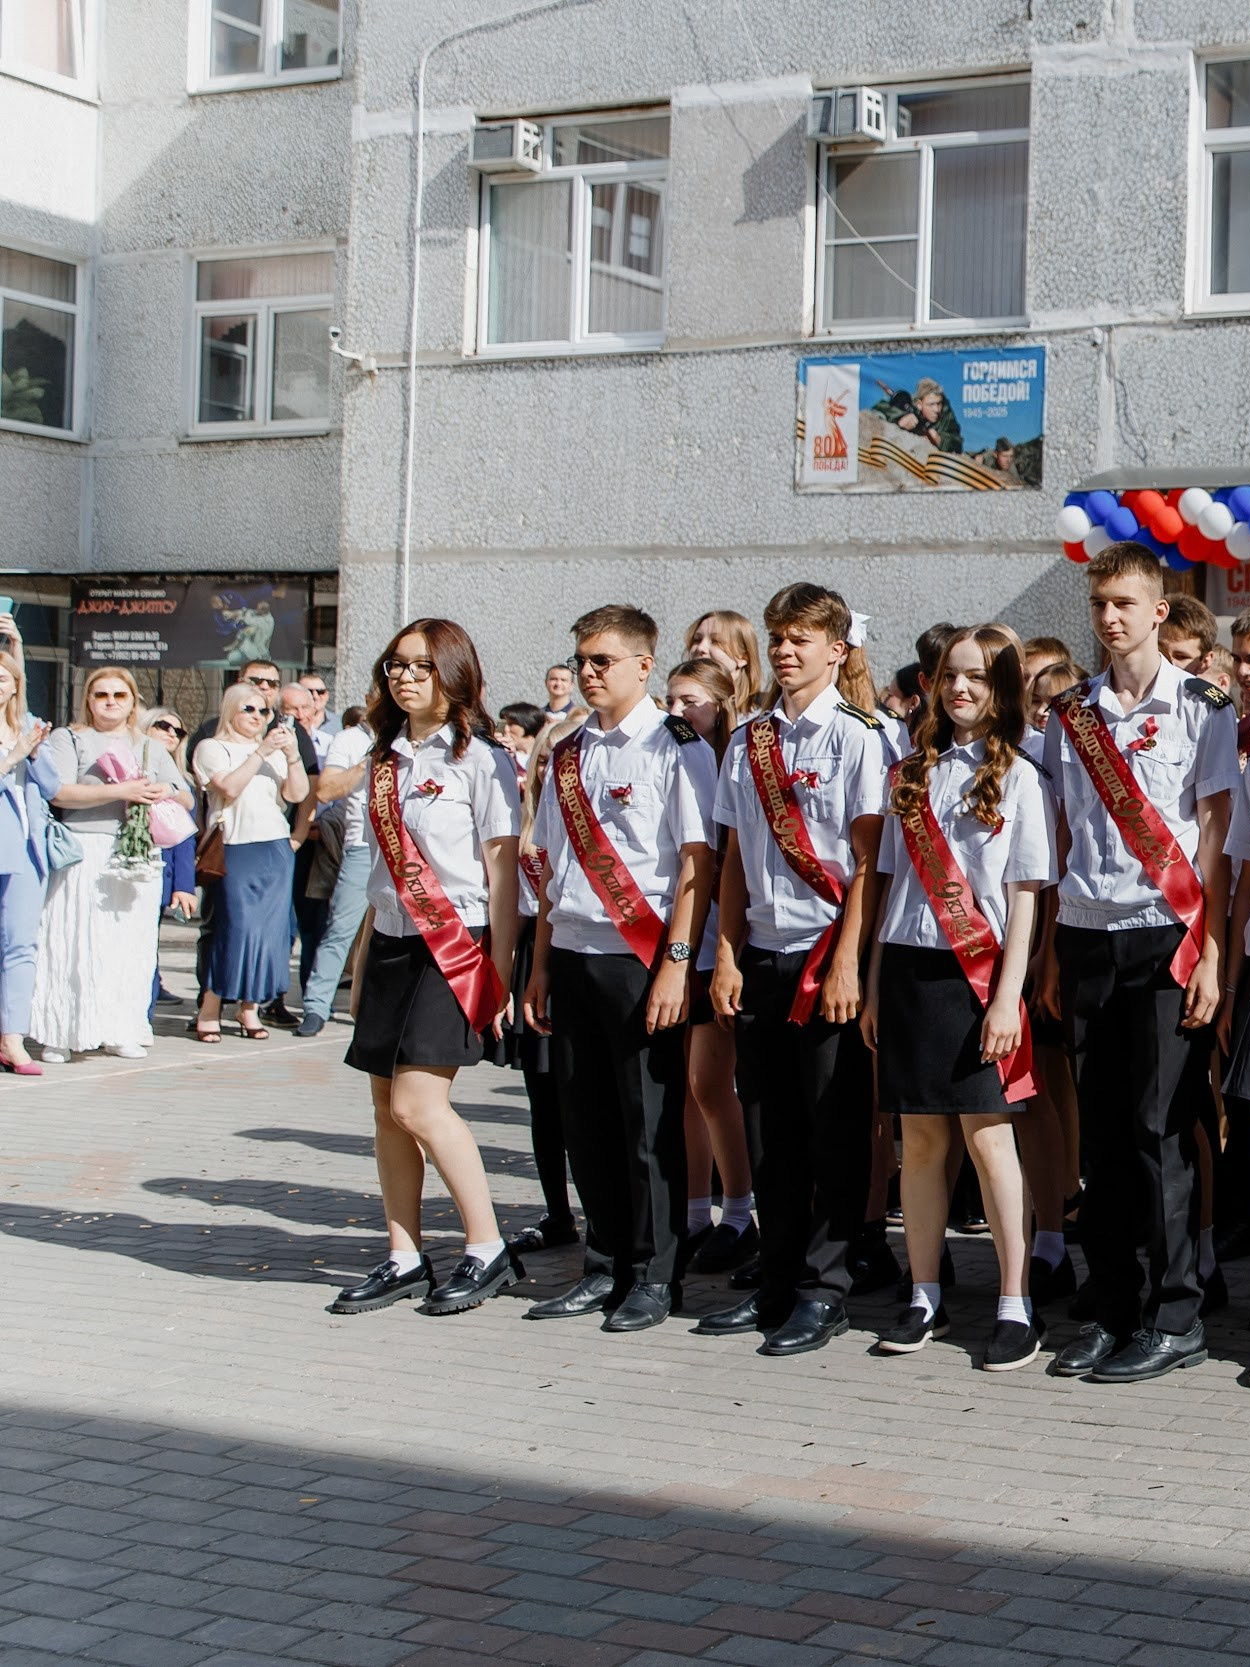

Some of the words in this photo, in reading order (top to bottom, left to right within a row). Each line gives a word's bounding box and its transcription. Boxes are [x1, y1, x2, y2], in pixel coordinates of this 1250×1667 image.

[963, 359, 1038, 383] ГОРДИМСЯ
[963, 380, 1031, 405] ПОБЕДОЙ!
[1113, 797, 1144, 818] 9
[772, 818, 800, 835] 9
[393, 862, 423, 879] 9
[586, 854, 616, 873] 9
[932, 881, 964, 899] 9
